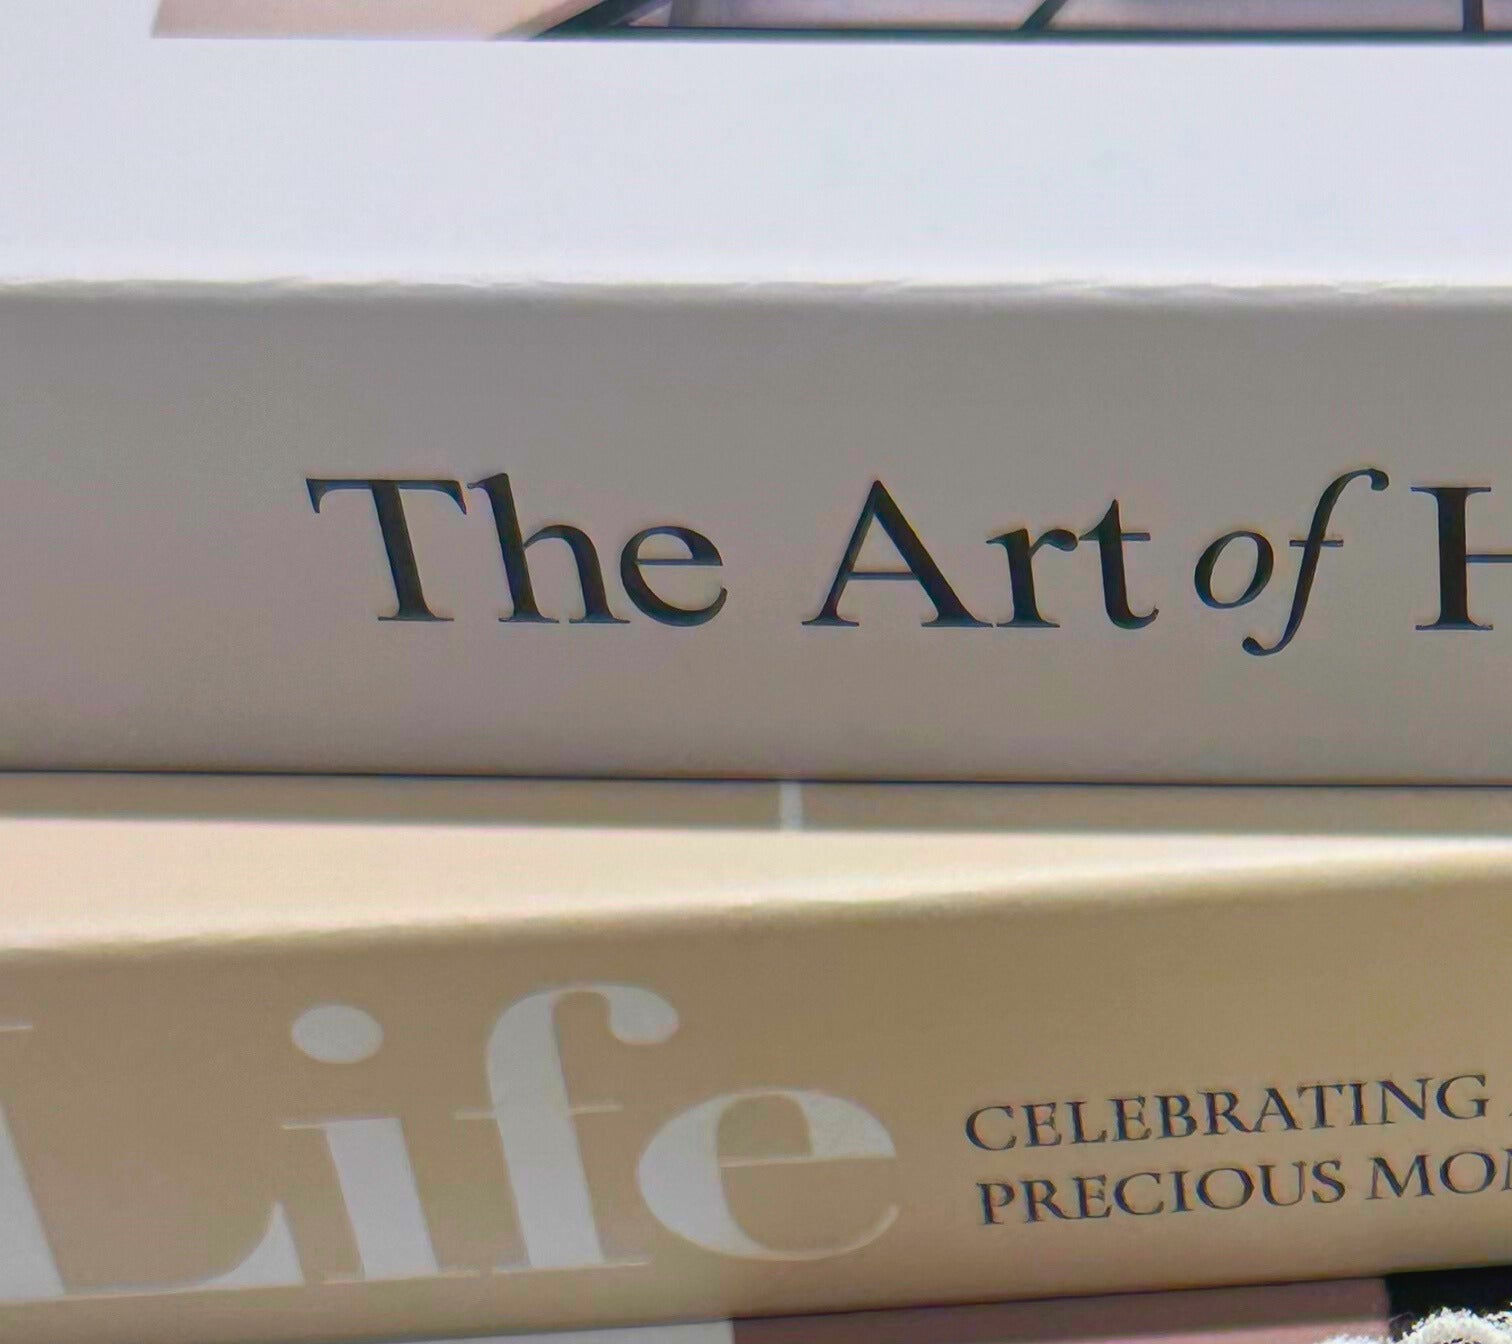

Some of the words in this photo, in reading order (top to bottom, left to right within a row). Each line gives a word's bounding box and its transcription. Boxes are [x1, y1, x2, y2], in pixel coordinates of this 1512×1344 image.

[306, 471, 728, 628] The
[800, 479, 1160, 631] Art
[1194, 467, 1390, 656] of
[964, 1073, 1491, 1152] CELEBRATING
[975, 1158, 1347, 1226] PRECIOUS
